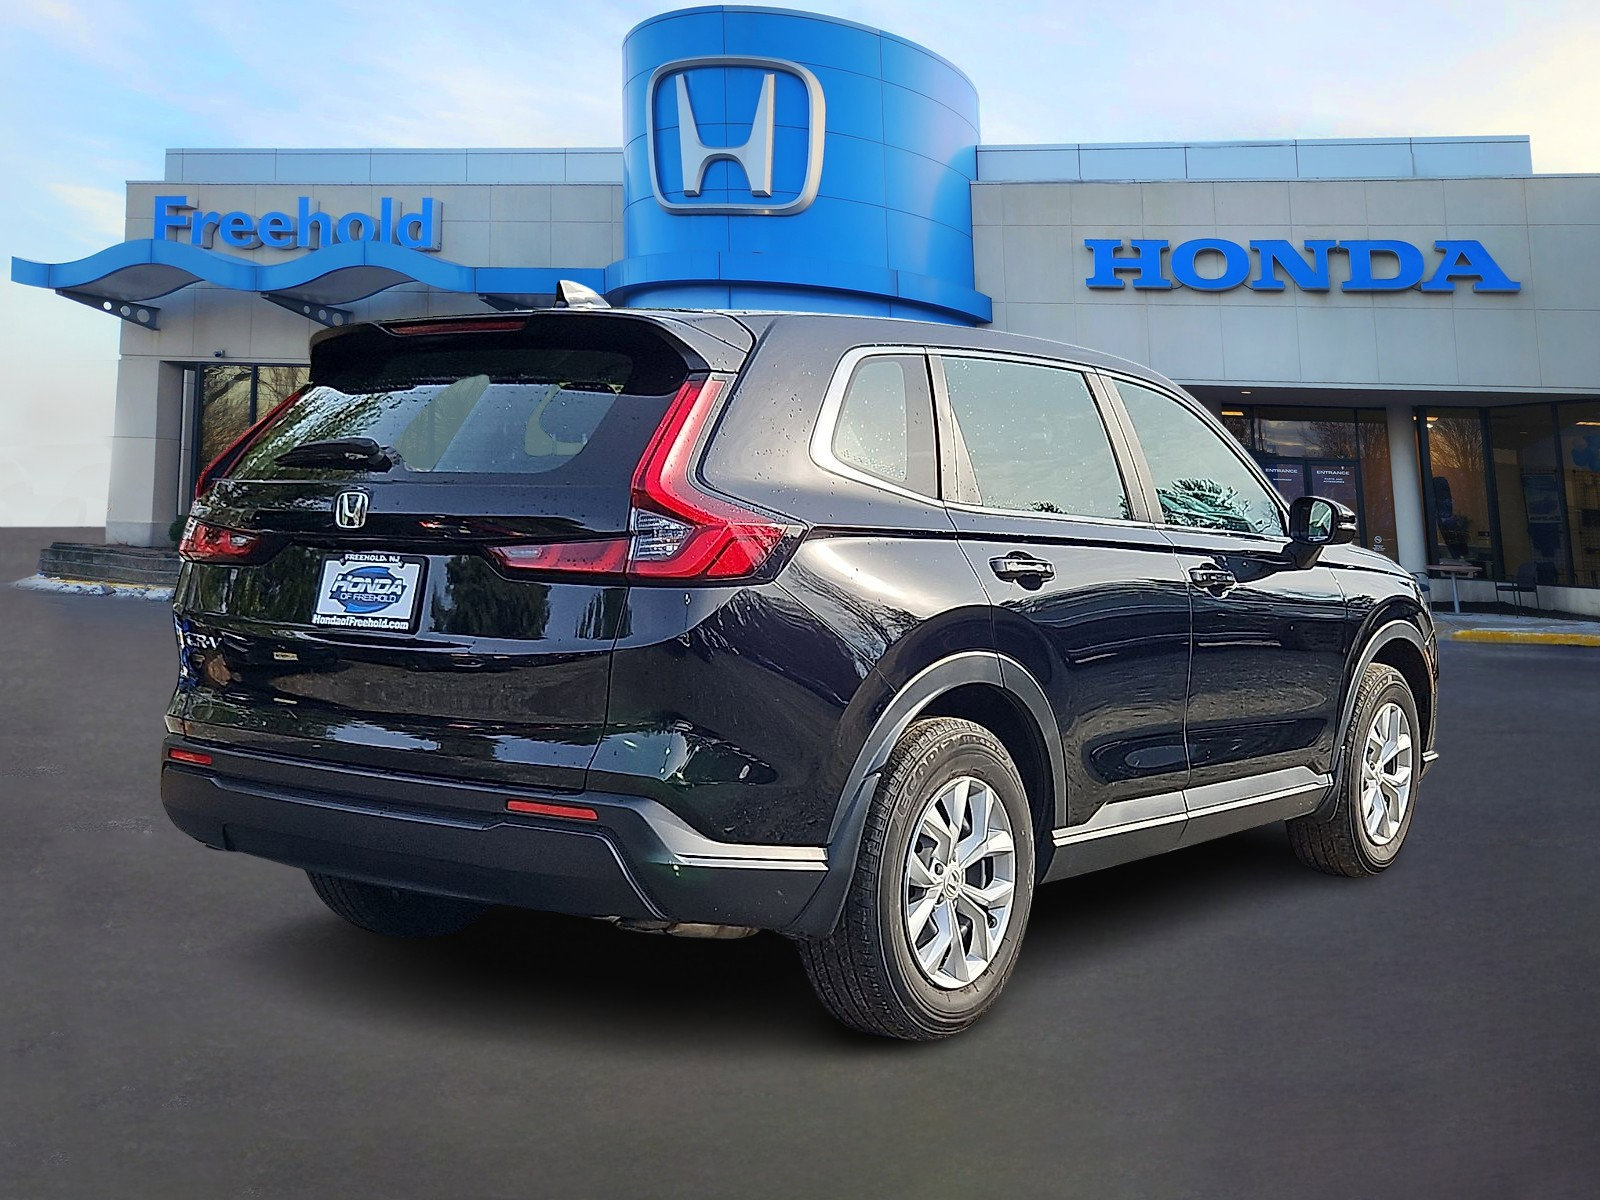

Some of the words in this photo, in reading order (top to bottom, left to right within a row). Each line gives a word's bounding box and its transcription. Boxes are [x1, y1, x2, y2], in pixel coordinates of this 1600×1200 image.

[153, 196, 442, 251] Freehold
[1084, 238, 1522, 294] HONDA
[331, 575, 403, 595] HONDA
[340, 592, 352, 600] OF
[353, 594, 397, 603] FREEHOLD
[312, 614, 409, 630] HondaofFreehold.com
